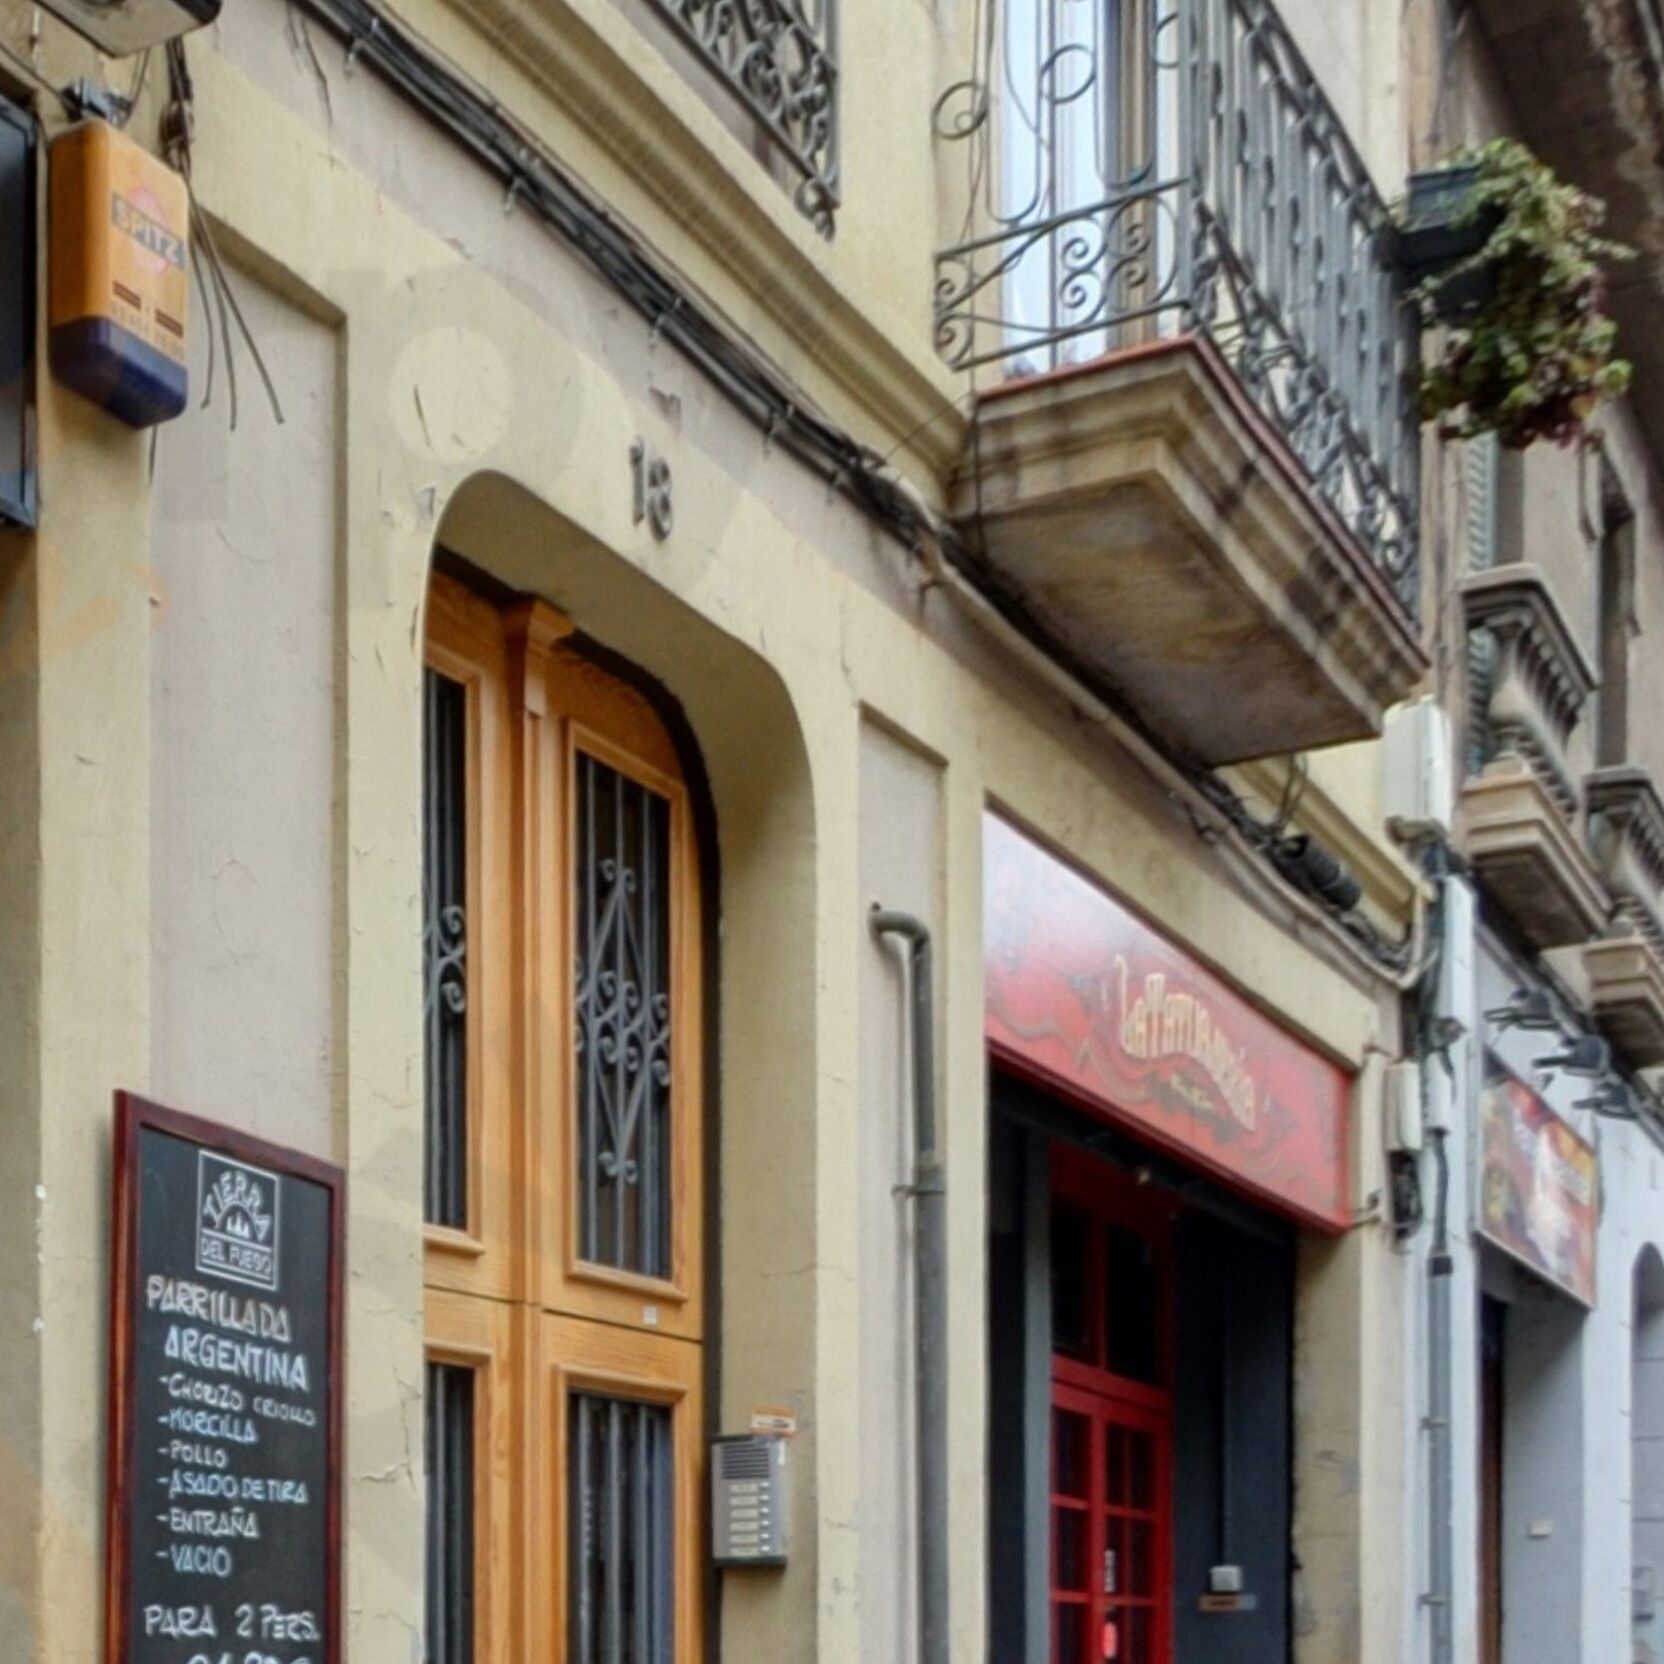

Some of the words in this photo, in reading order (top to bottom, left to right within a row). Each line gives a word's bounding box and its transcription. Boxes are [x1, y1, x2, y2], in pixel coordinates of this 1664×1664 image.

[203, 1170, 272, 1241] TIERRA
[201, 1237, 225, 1263] DEL
[230, 1246, 273, 1274] FUEGO
[146, 1274, 292, 1344] PARRILLADA
[164, 1326, 309, 1391] ARGENTINA
[241, 1478, 264, 1500] DE
[267, 1480, 308, 1503] TIRA
[145, 1604, 216, 1639] PARA
[235, 1603, 254, 1637] 2
